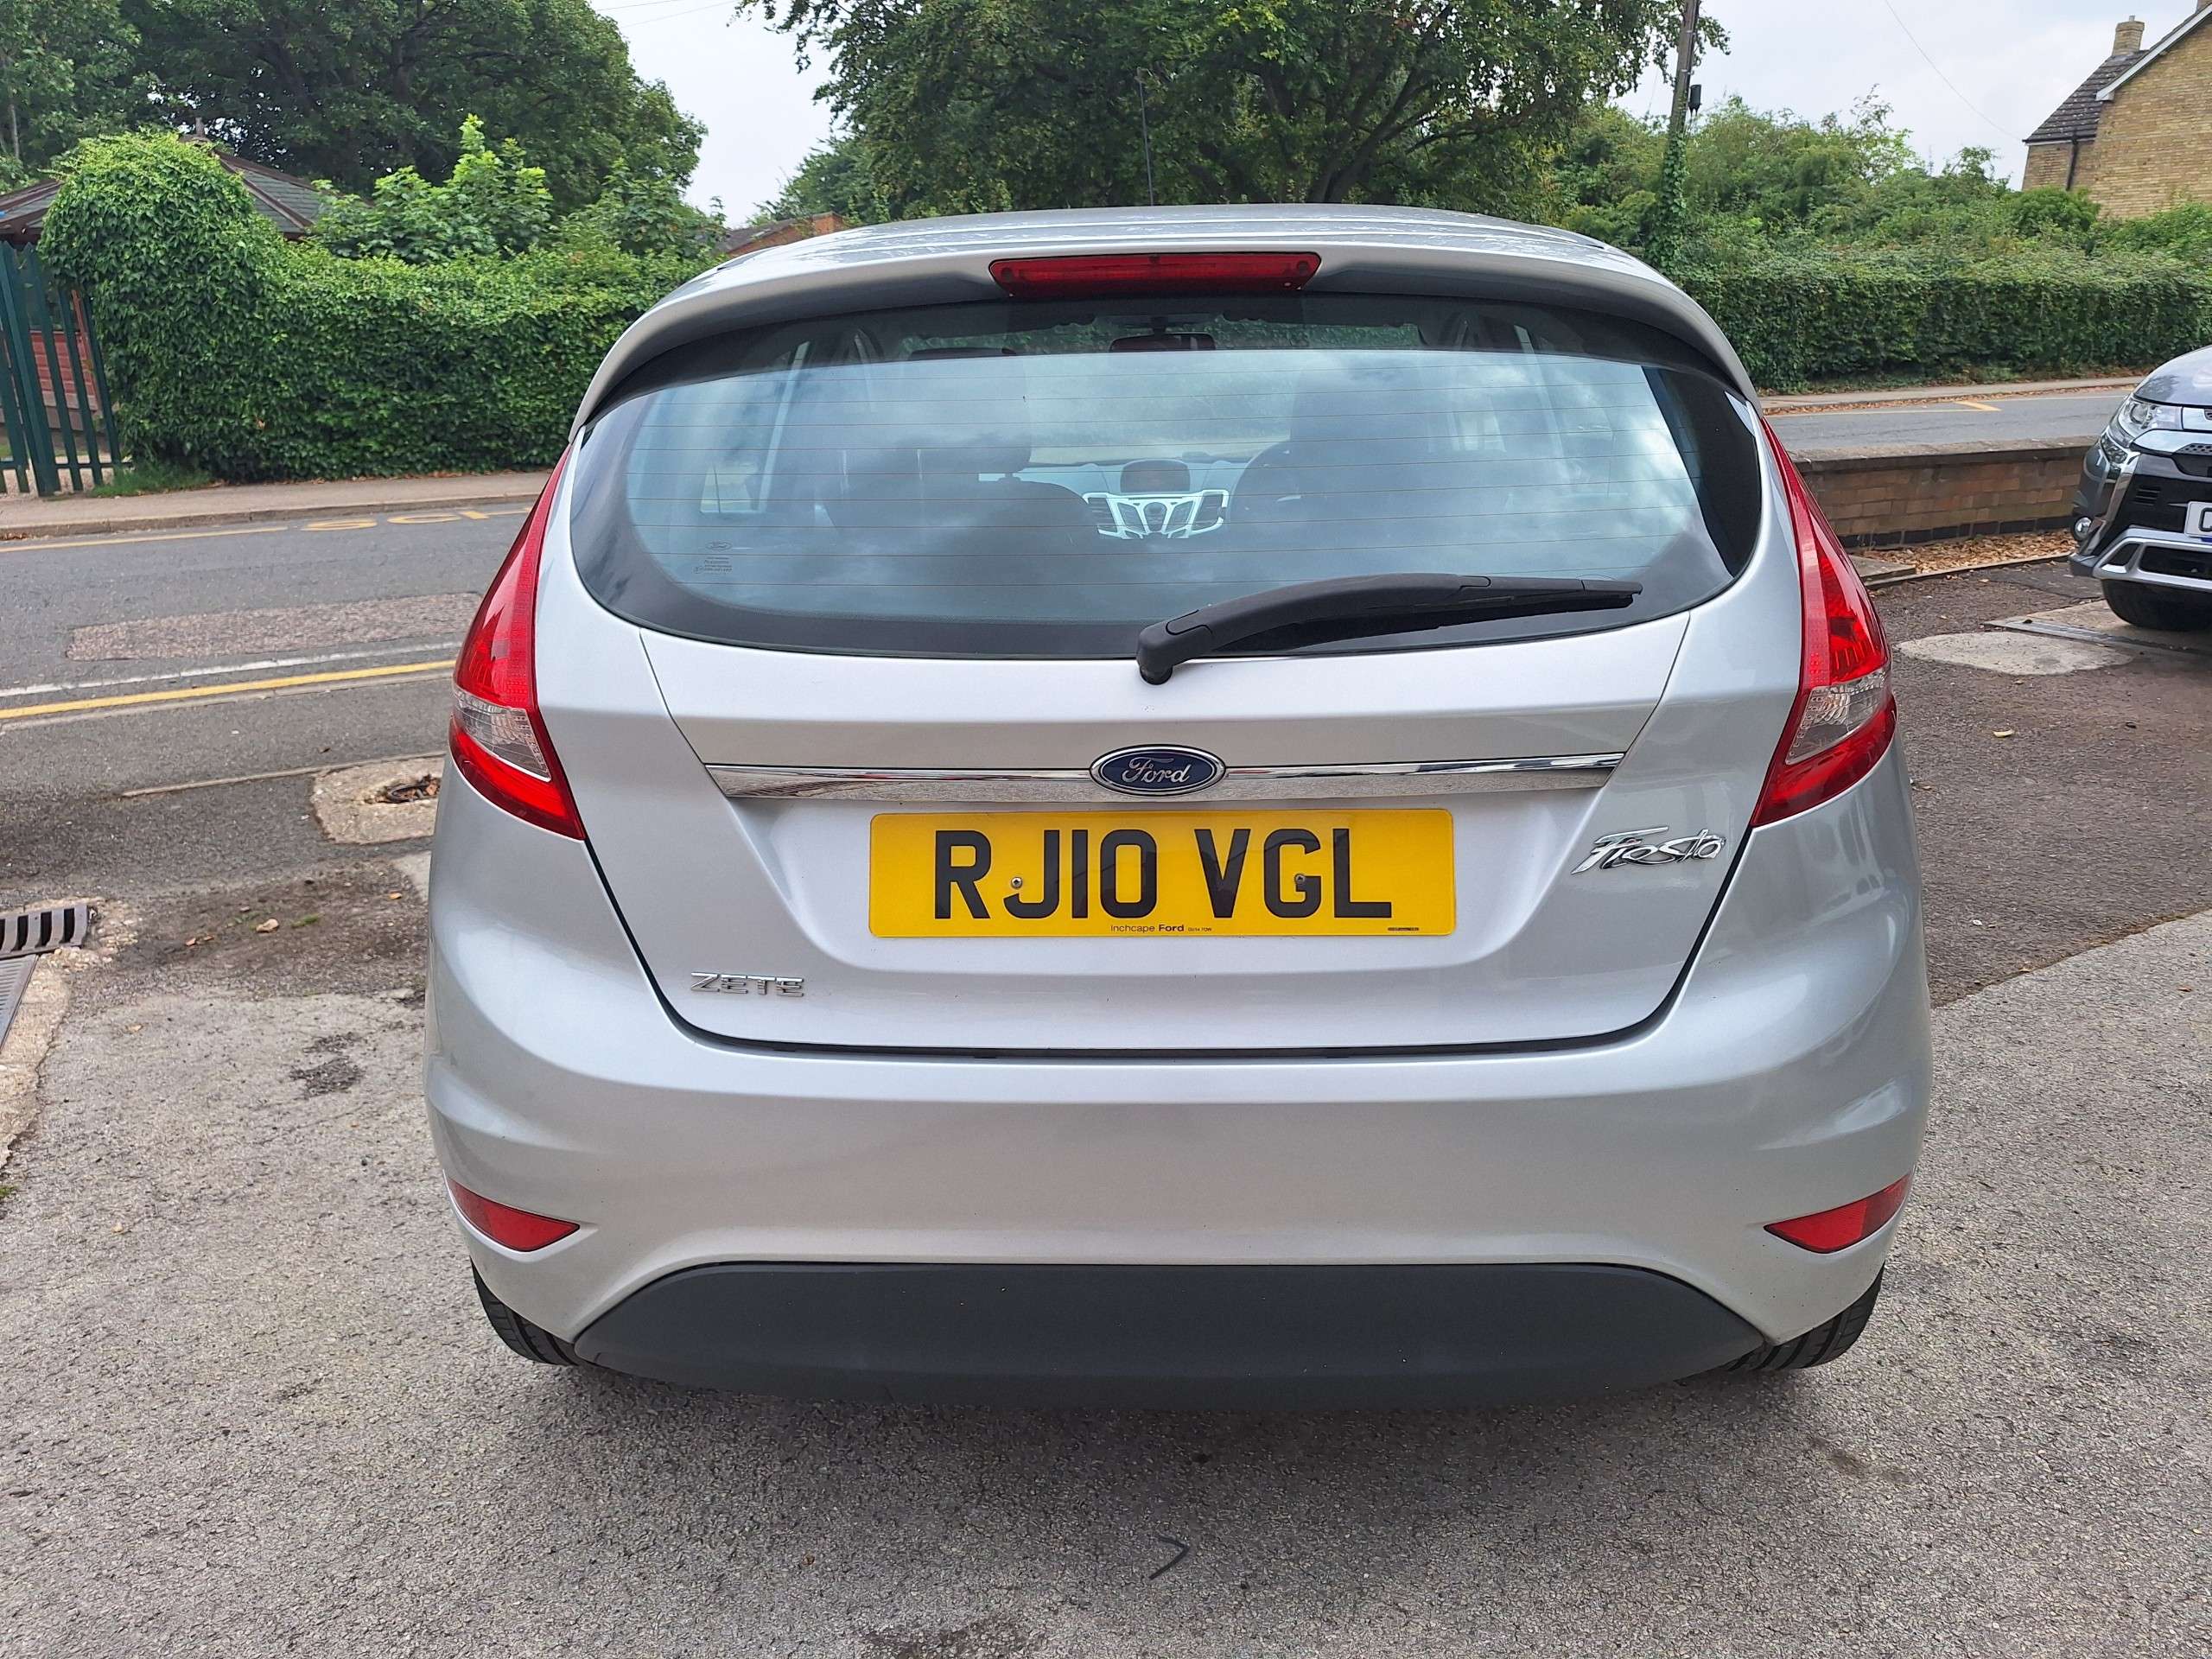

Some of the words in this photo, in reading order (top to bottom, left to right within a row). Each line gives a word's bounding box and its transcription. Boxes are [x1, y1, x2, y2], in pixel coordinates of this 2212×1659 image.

[1122, 757, 1192, 783] Ford
[1571, 826, 1726, 874] Fiesta
[934, 830, 1158, 918] RJ10
[1194, 829, 1392, 918] VGL
[1110, 924, 1155, 932] Inchcape
[690, 971, 804, 997] ZETE
